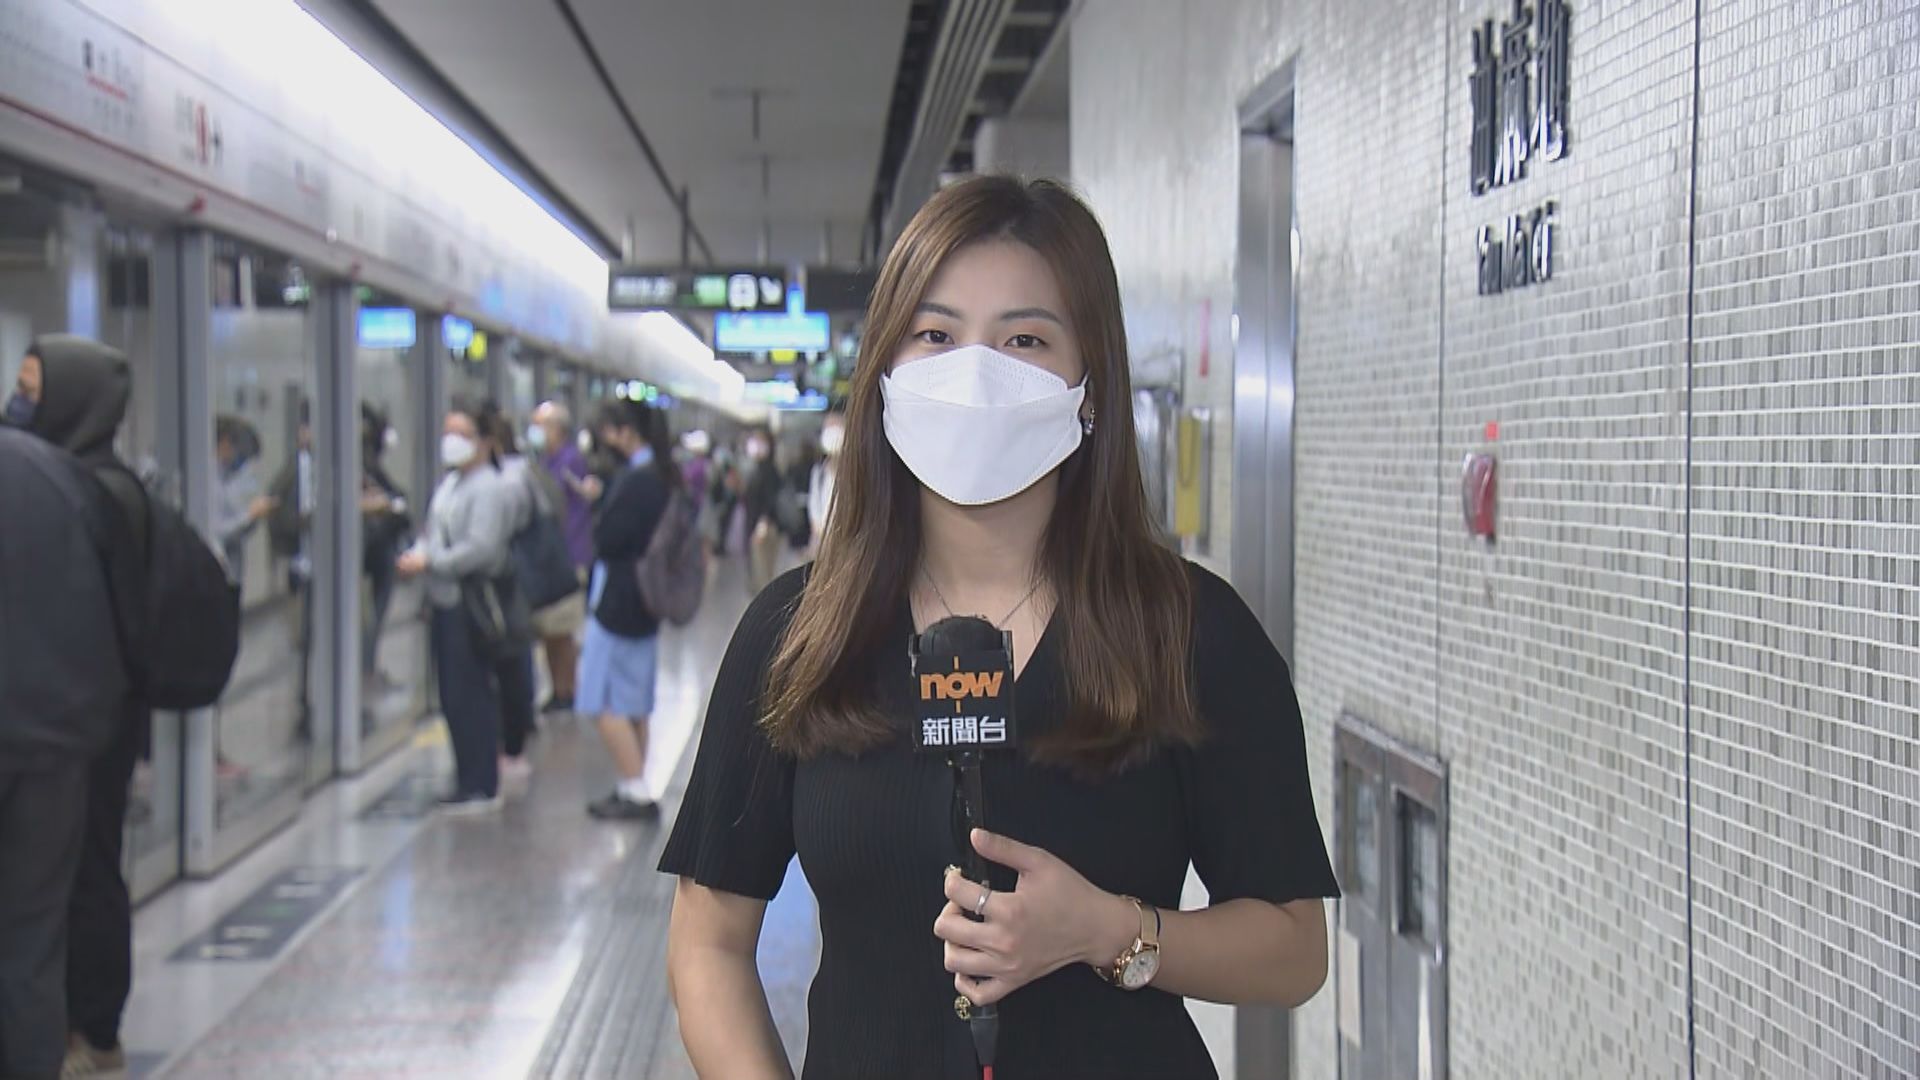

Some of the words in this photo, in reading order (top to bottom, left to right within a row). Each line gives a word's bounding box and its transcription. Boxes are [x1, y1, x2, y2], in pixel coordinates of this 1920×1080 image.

[920, 669, 1004, 702] now
[922, 716, 1006, 746] 新聞台
